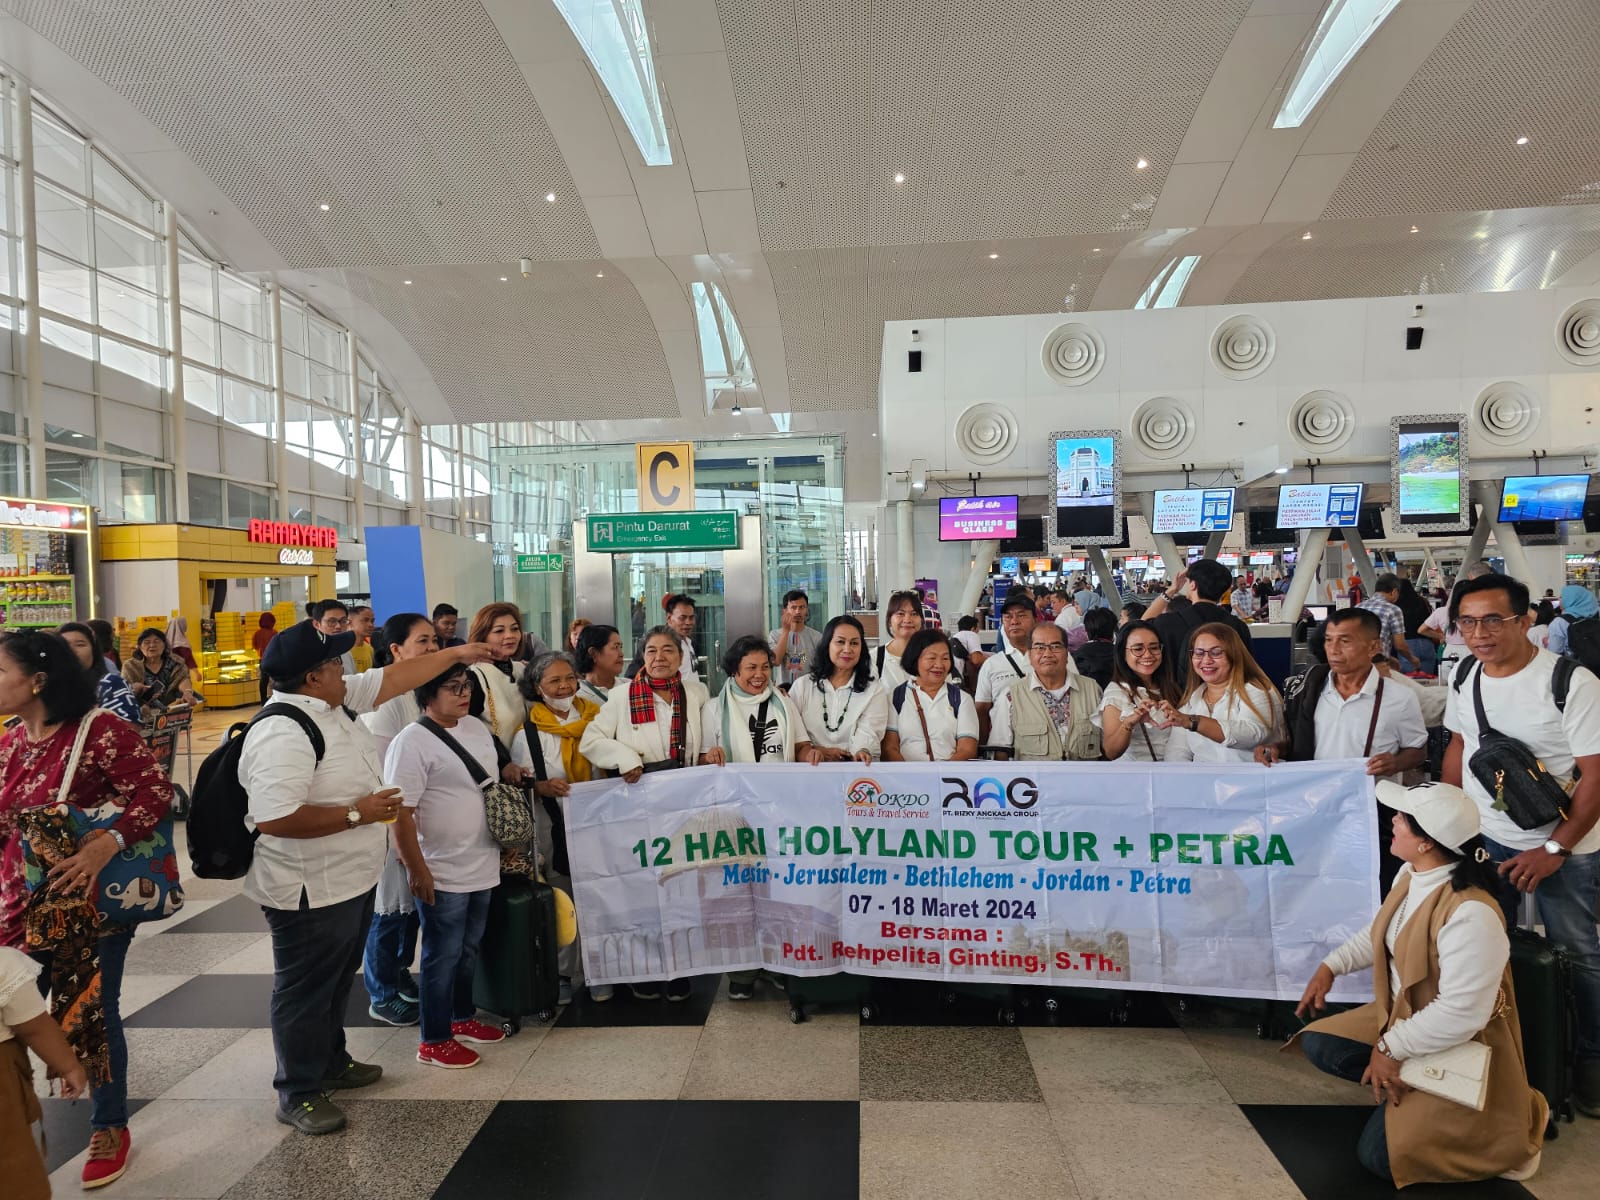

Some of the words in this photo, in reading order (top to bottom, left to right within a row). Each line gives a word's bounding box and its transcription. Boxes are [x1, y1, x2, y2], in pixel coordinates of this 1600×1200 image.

[649, 451, 680, 506] C
[250, 518, 337, 548] RAMAYANA
[616, 521, 645, 532] Pintu
[648, 520, 690, 532] Darurat
[954, 520, 1003, 528] BUSINESS
[761, 743, 783, 756] das
[941, 777, 1039, 809] RAG
[847, 807, 867, 817] Tours
[869, 808, 875, 818] &
[877, 808, 901, 818] Travel
[902, 809, 929, 818] Service
[632, 838, 673, 867] 12
[685, 827, 767, 862] HARI
[779, 825, 977, 859] HOLYLAND
[989, 830, 1099, 861] TOUR
[1113, 836, 1134, 858] +
[1149, 833, 1295, 866] PETRA
[722, 863, 770, 886] Mesir
[783, 862, 888, 886] Jerusalem
[904, 865, 1014, 889] Bethlehem
[1031, 868, 1111, 892] Jordan
[1129, 869, 1192, 894] Petra
[849, 895, 872, 914] 07
[892, 896, 915, 916] 18
[921, 897, 979, 918] Maret
[986, 899, 1037, 920] 2024
[881, 921, 987, 942] Bersama
[783, 943, 824, 961] Pdt.
[832, 941, 942, 965] Rehpelita
[949, 947, 1047, 973] Ginting,
[1055, 951, 1122, 972] S.Th.
